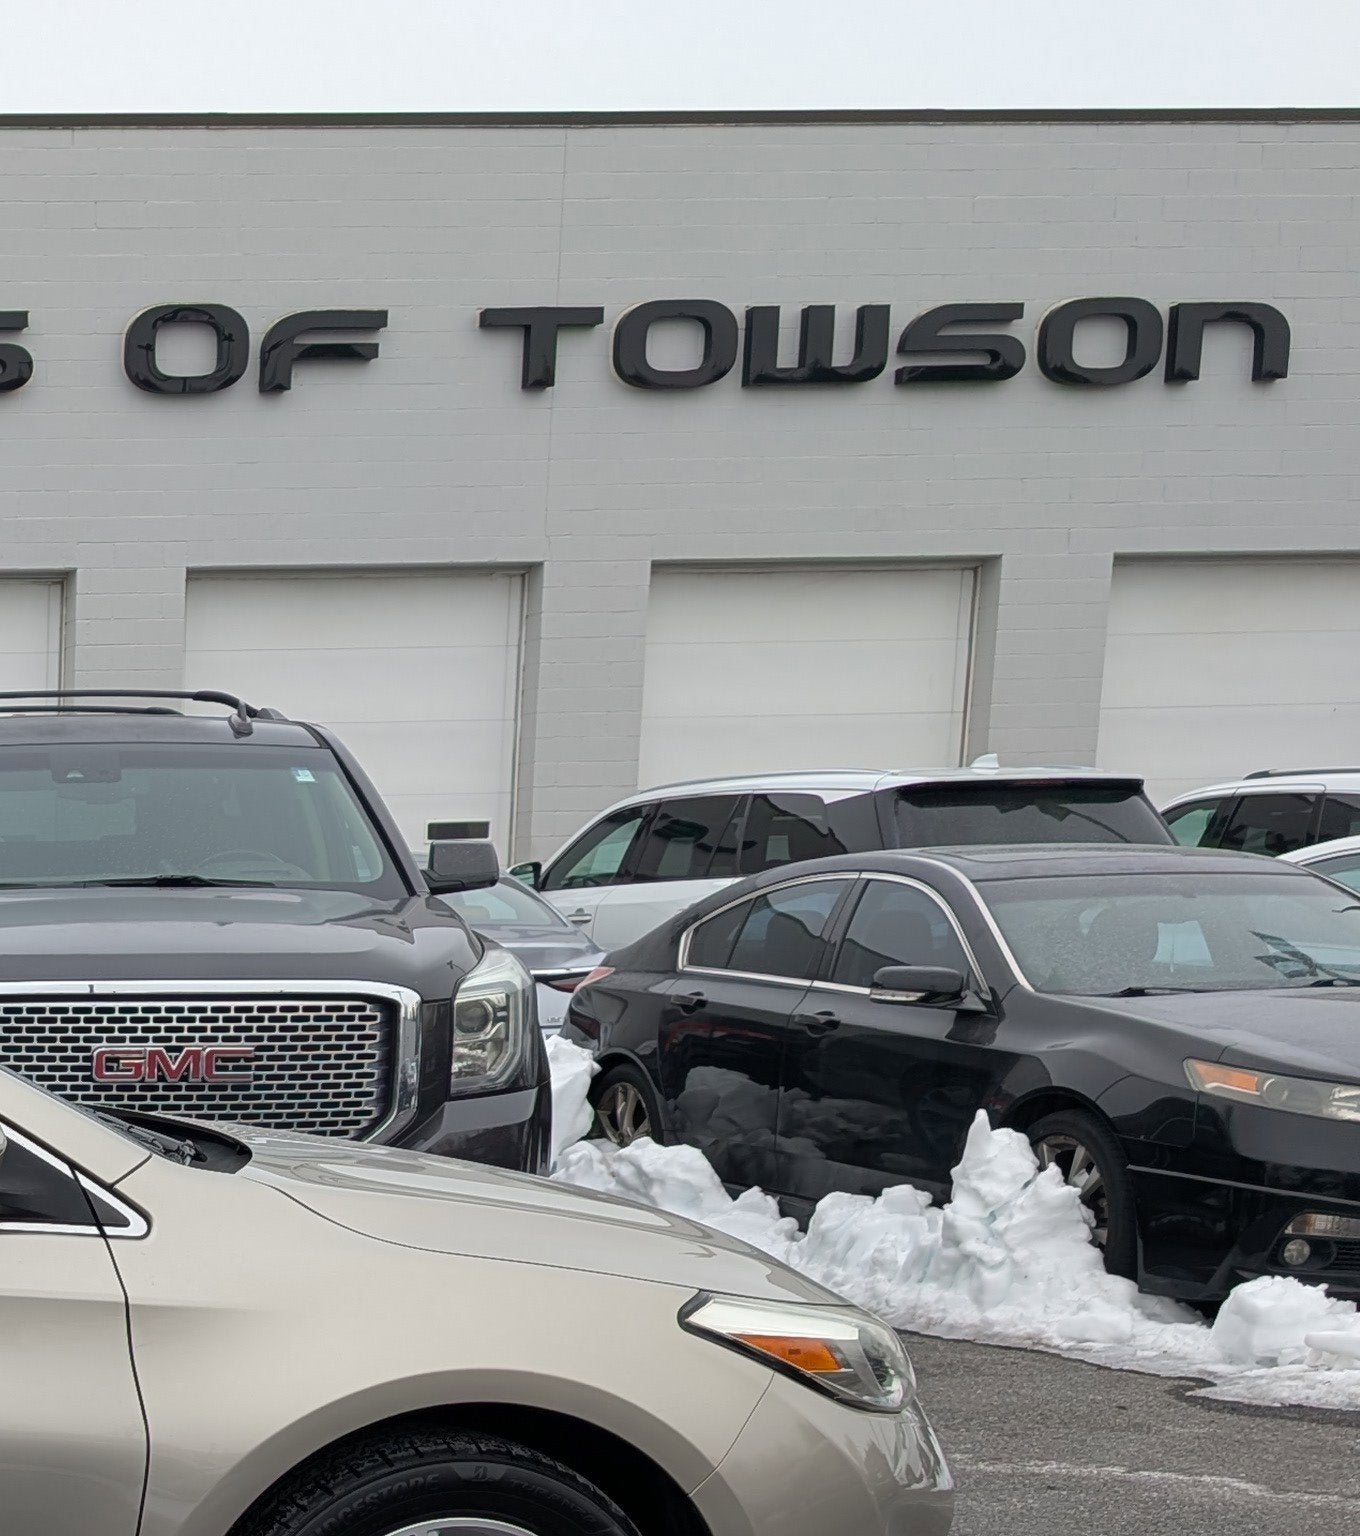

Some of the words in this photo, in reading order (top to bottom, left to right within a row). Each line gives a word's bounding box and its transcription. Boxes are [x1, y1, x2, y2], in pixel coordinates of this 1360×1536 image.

[123, 303, 389, 395] OF
[478, 297, 1291, 392] TOWSON
[92, 1046, 256, 1083] GMC
